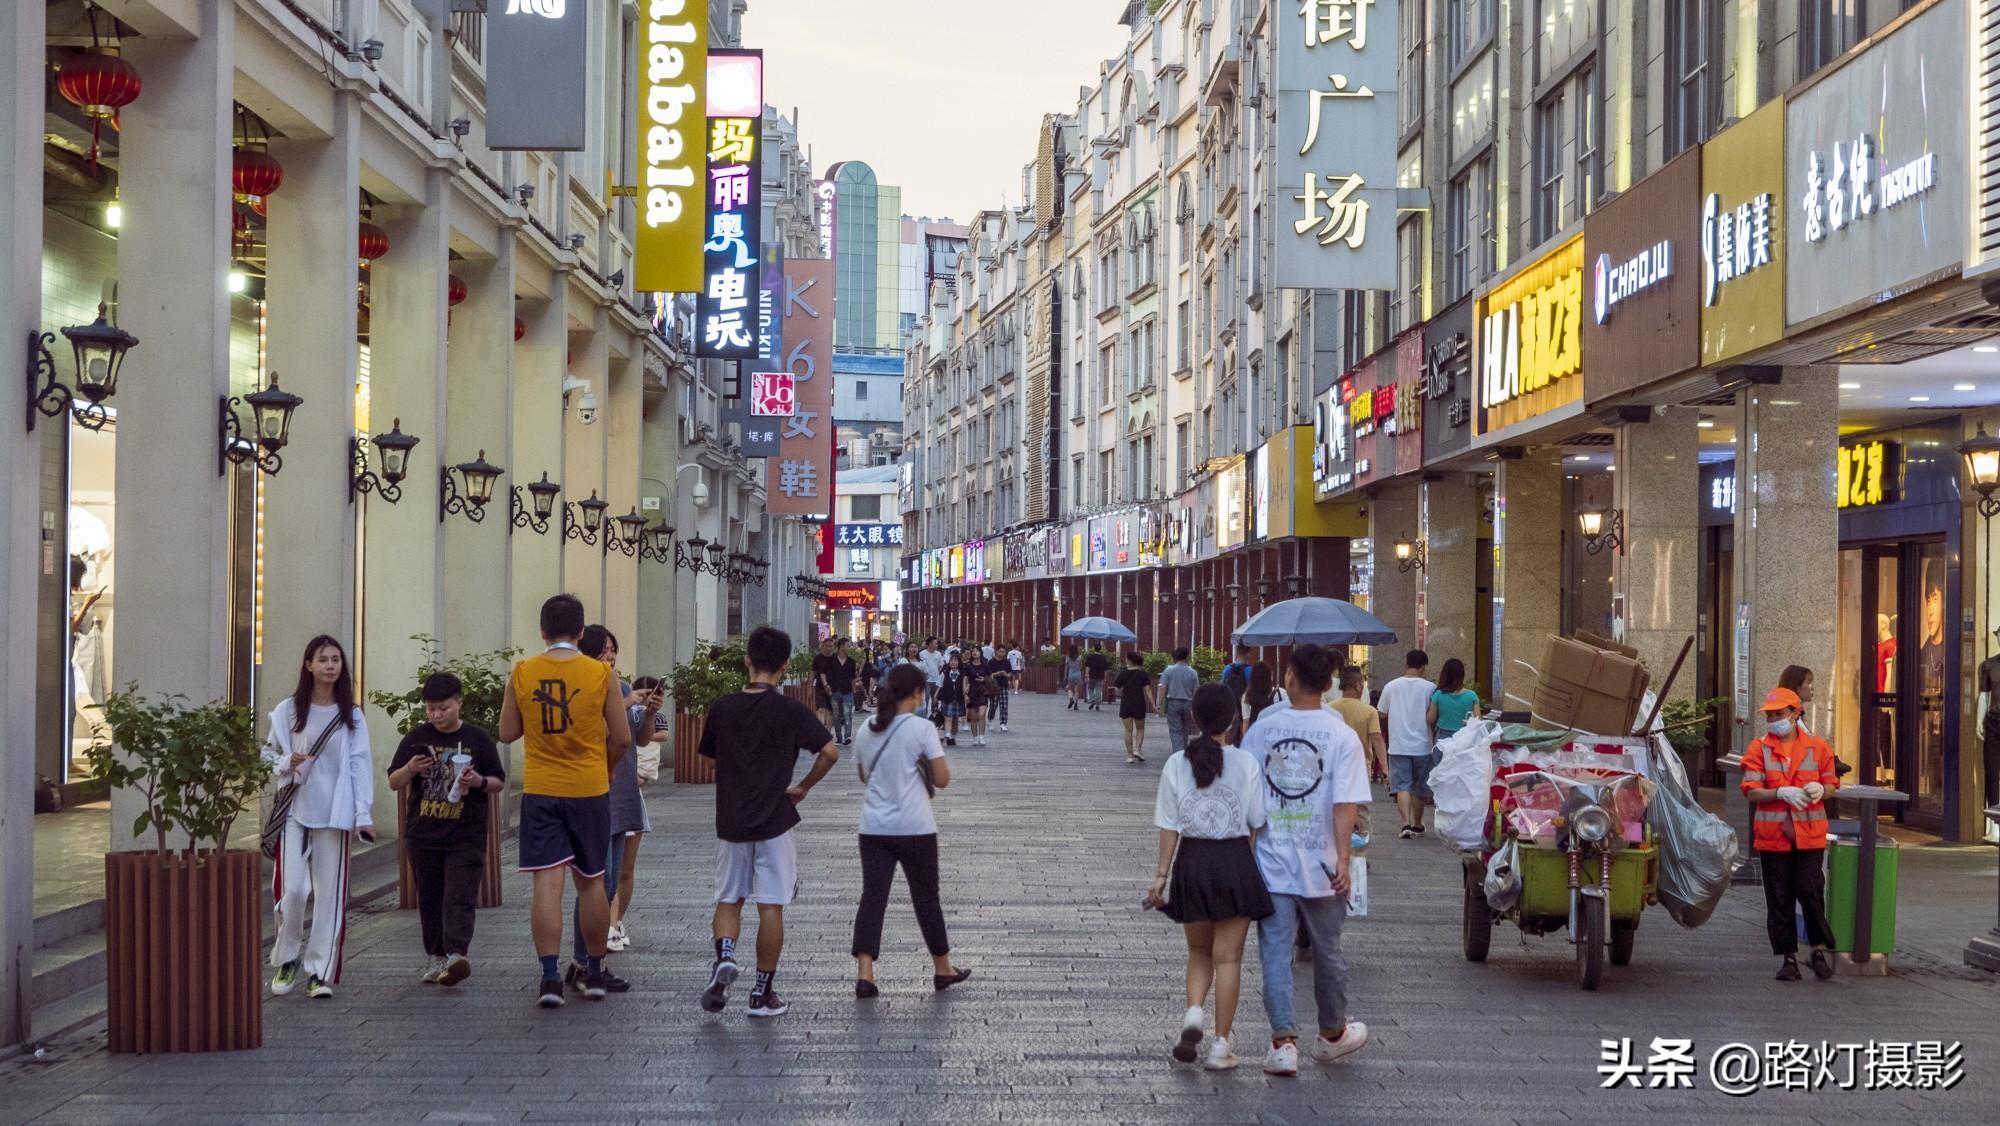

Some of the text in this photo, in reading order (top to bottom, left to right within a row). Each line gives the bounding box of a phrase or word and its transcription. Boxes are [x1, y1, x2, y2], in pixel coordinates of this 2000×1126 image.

[1293, 0, 1374, 249] 街广场
[704, 118, 758, 350] 玛丽奥电玩
[1608, 240, 1671, 305] CHAOJU
[1483, 302, 1519, 408] HLA
[838, 526, 903, 544] 光大眼镜
